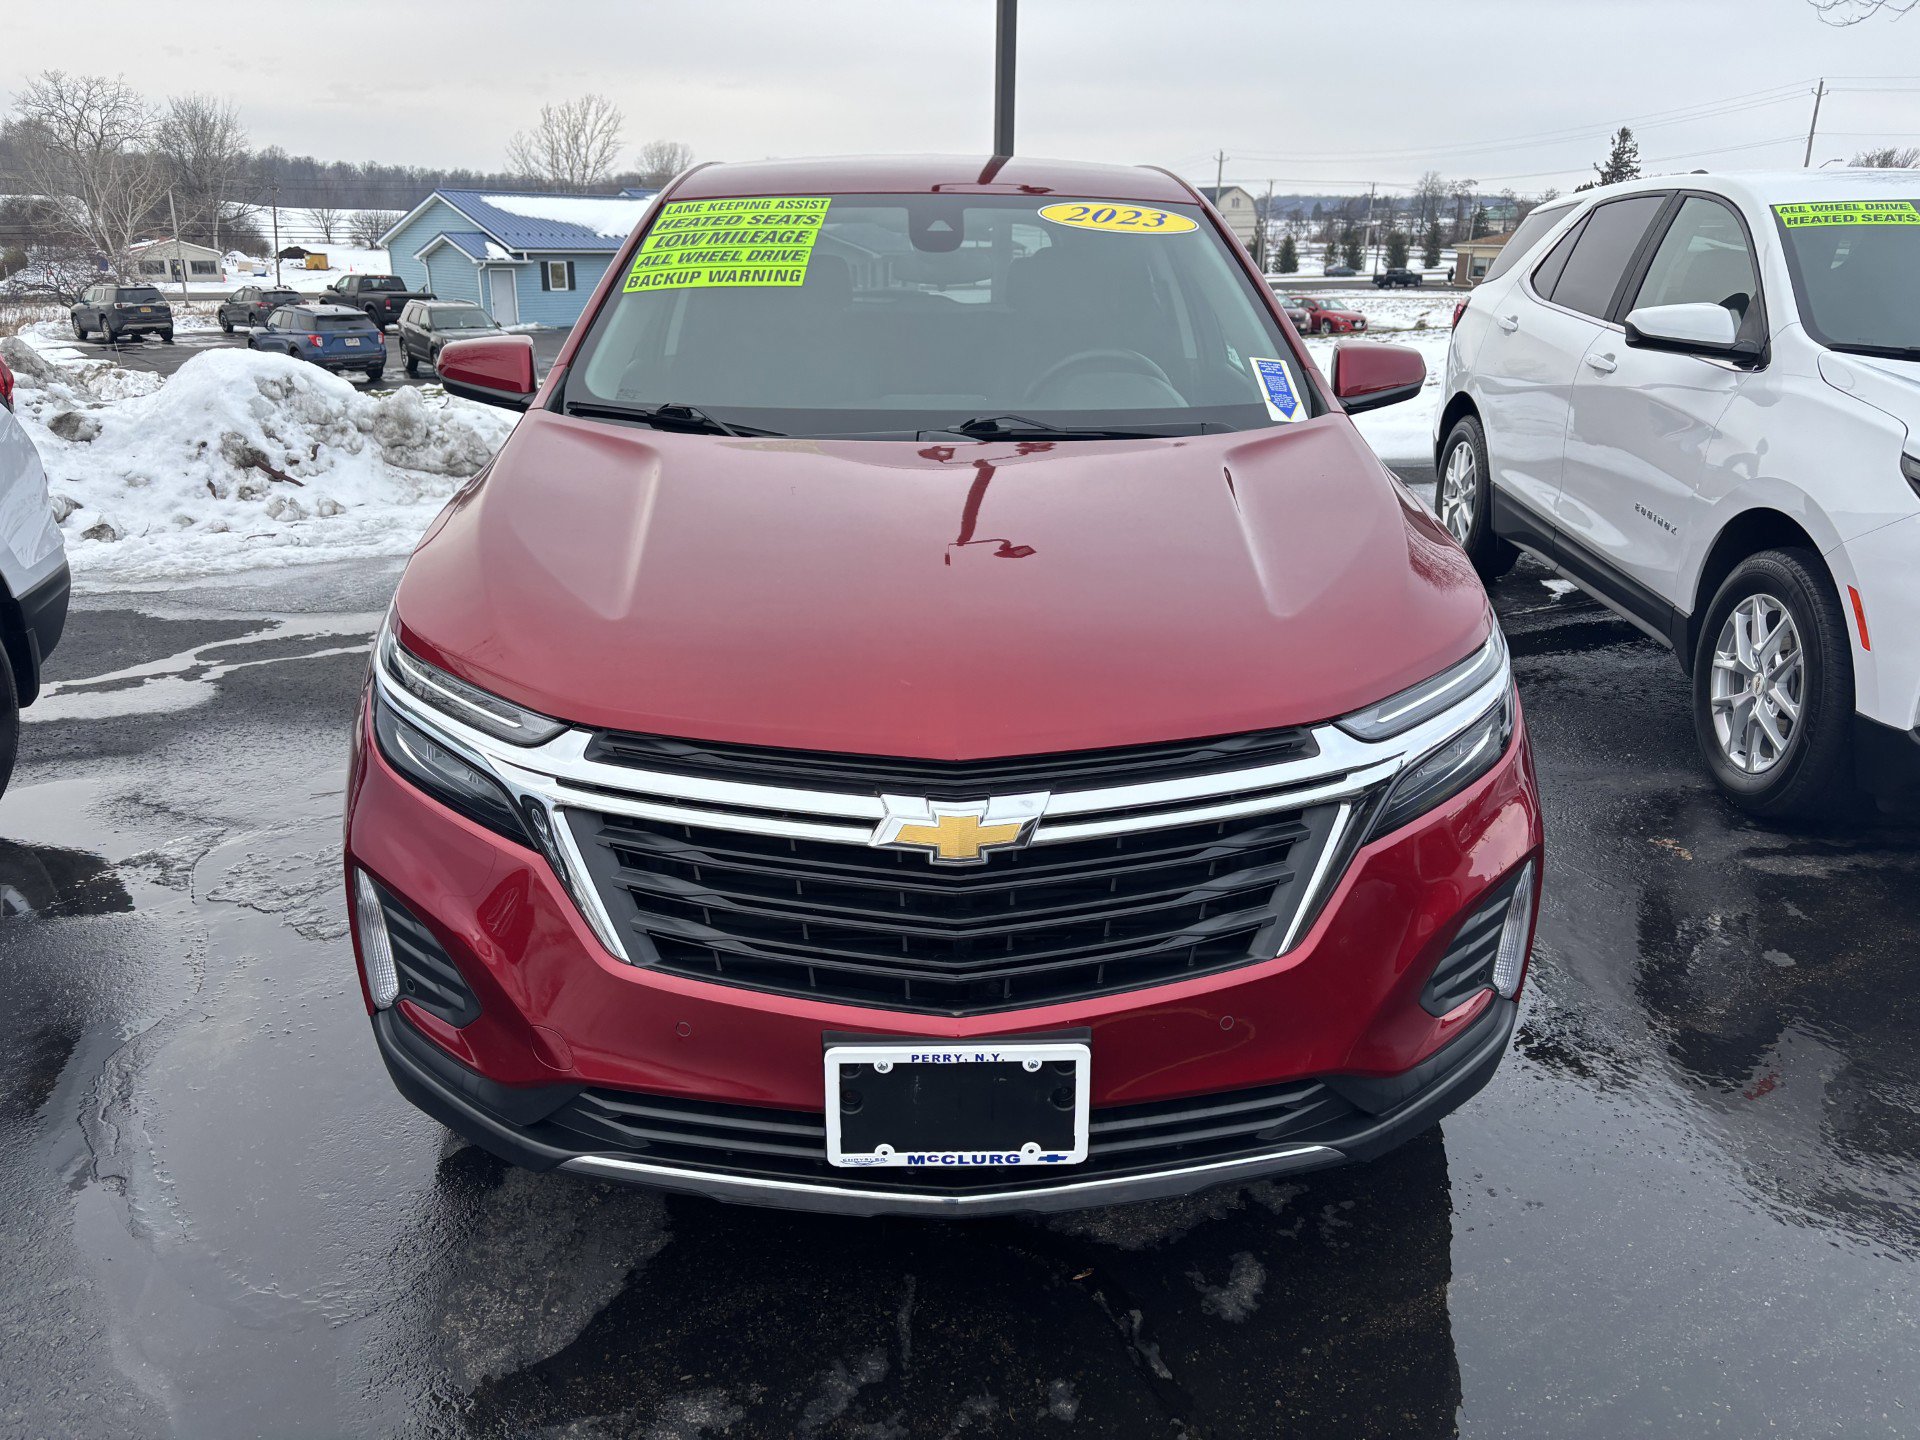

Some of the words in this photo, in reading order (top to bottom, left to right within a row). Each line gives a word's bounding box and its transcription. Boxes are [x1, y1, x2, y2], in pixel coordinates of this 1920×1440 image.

[665, 203, 702, 215] LANE
[707, 200, 771, 212] KEEPING
[775, 199, 828, 211] ASSIST
[1780, 205, 1809, 214] ALL
[1810, 203, 1863, 212] WHEEL
[1865, 203, 1911, 211] DRIVE
[656, 214, 746, 231] HEATED
[747, 213, 822, 226] SEATS
[1064, 206, 1168, 227] 2023
[1786, 214, 1857, 225] HEATED
[1861, 213, 1920, 223] SEATS
[653, 233, 707, 250] LOW
[705, 230, 812, 246] MILEAGE
[637, 251, 673, 269] ALL
[677, 250, 743, 265] WHEEL
[746, 248, 809, 263] DRIVE
[627, 271, 702, 289] BACKUP
[708, 269, 802, 284] WARNING
[911, 1053, 968, 1063] PERRY,
[975, 1053, 1005, 1062] N.Y.
